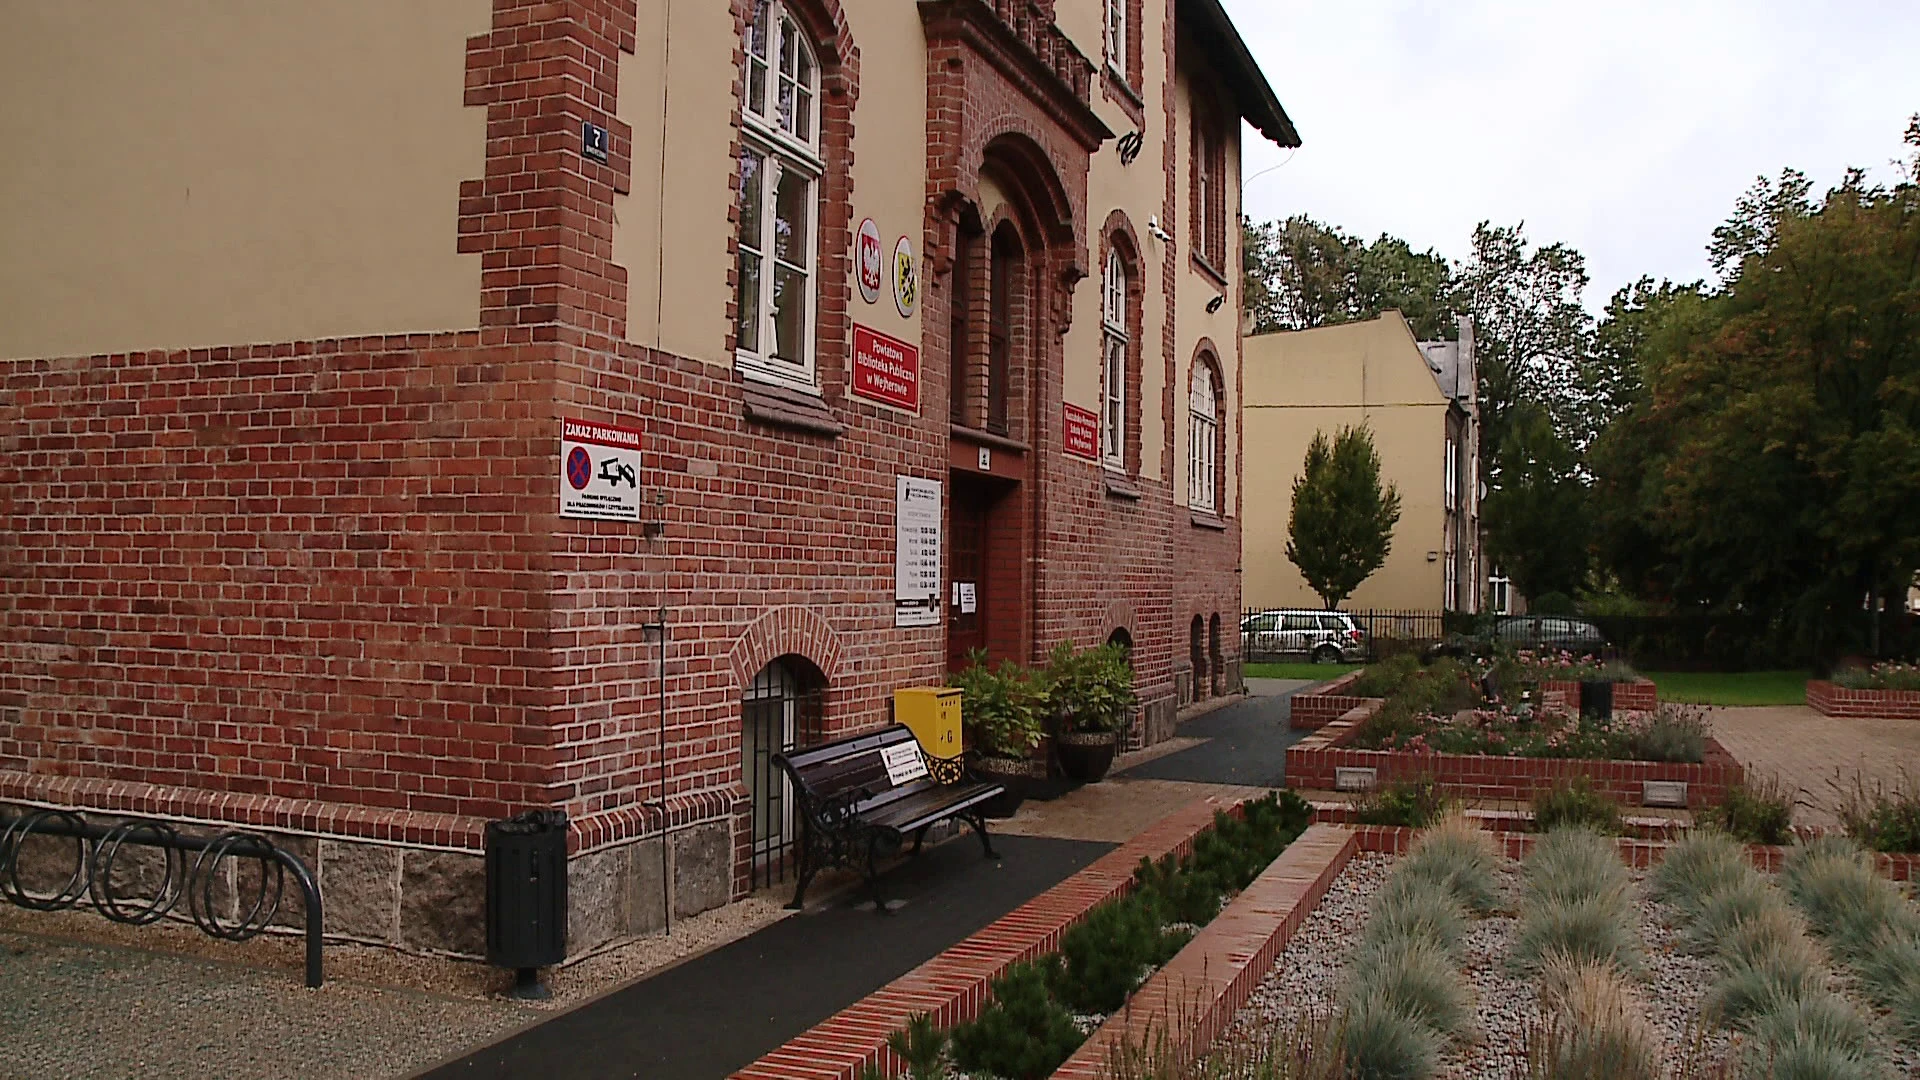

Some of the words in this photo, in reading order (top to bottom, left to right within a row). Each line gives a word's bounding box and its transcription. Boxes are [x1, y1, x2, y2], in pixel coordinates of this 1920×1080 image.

[593, 128, 601, 148] 7
[872, 339, 903, 362] Powiatowa
[857, 351, 889, 373] Biblioteka
[889, 361, 915, 383] Publiczna
[866, 373, 873, 385] w
[873, 373, 908, 396] Wejherowie
[565, 422, 591, 439] ZAKAZ
[592, 427, 639, 446] PARKOWANIA
